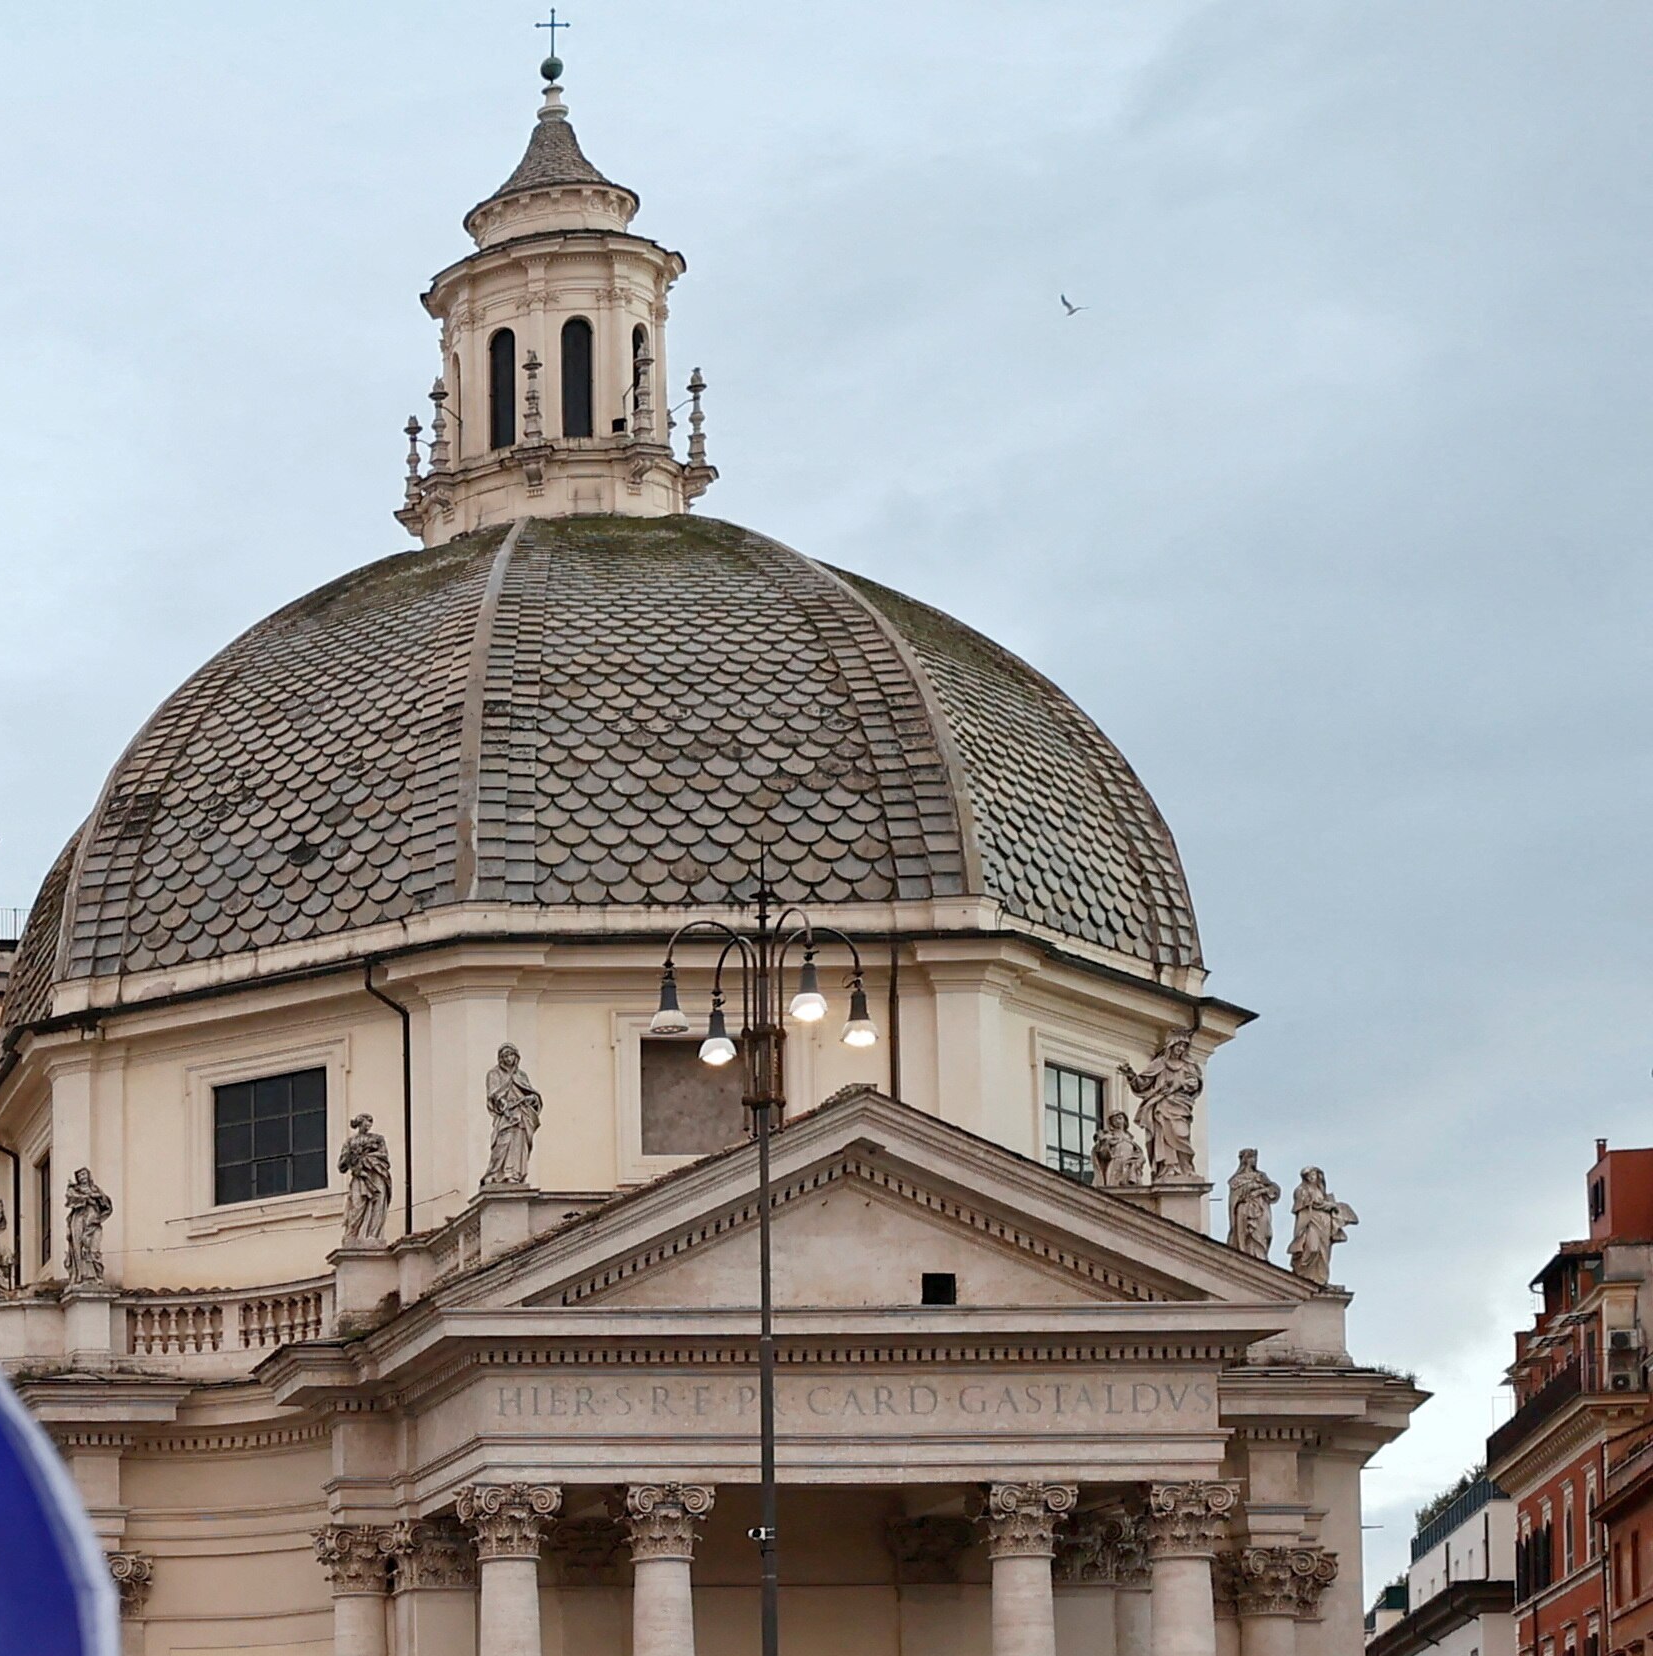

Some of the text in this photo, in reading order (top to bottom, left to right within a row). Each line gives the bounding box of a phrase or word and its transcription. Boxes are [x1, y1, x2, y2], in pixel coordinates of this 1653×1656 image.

[497, 1386, 596, 1418] HIER
[807, 1385, 938, 1416] CARD
[959, 1383, 1213, 1416] GASTALDVS
